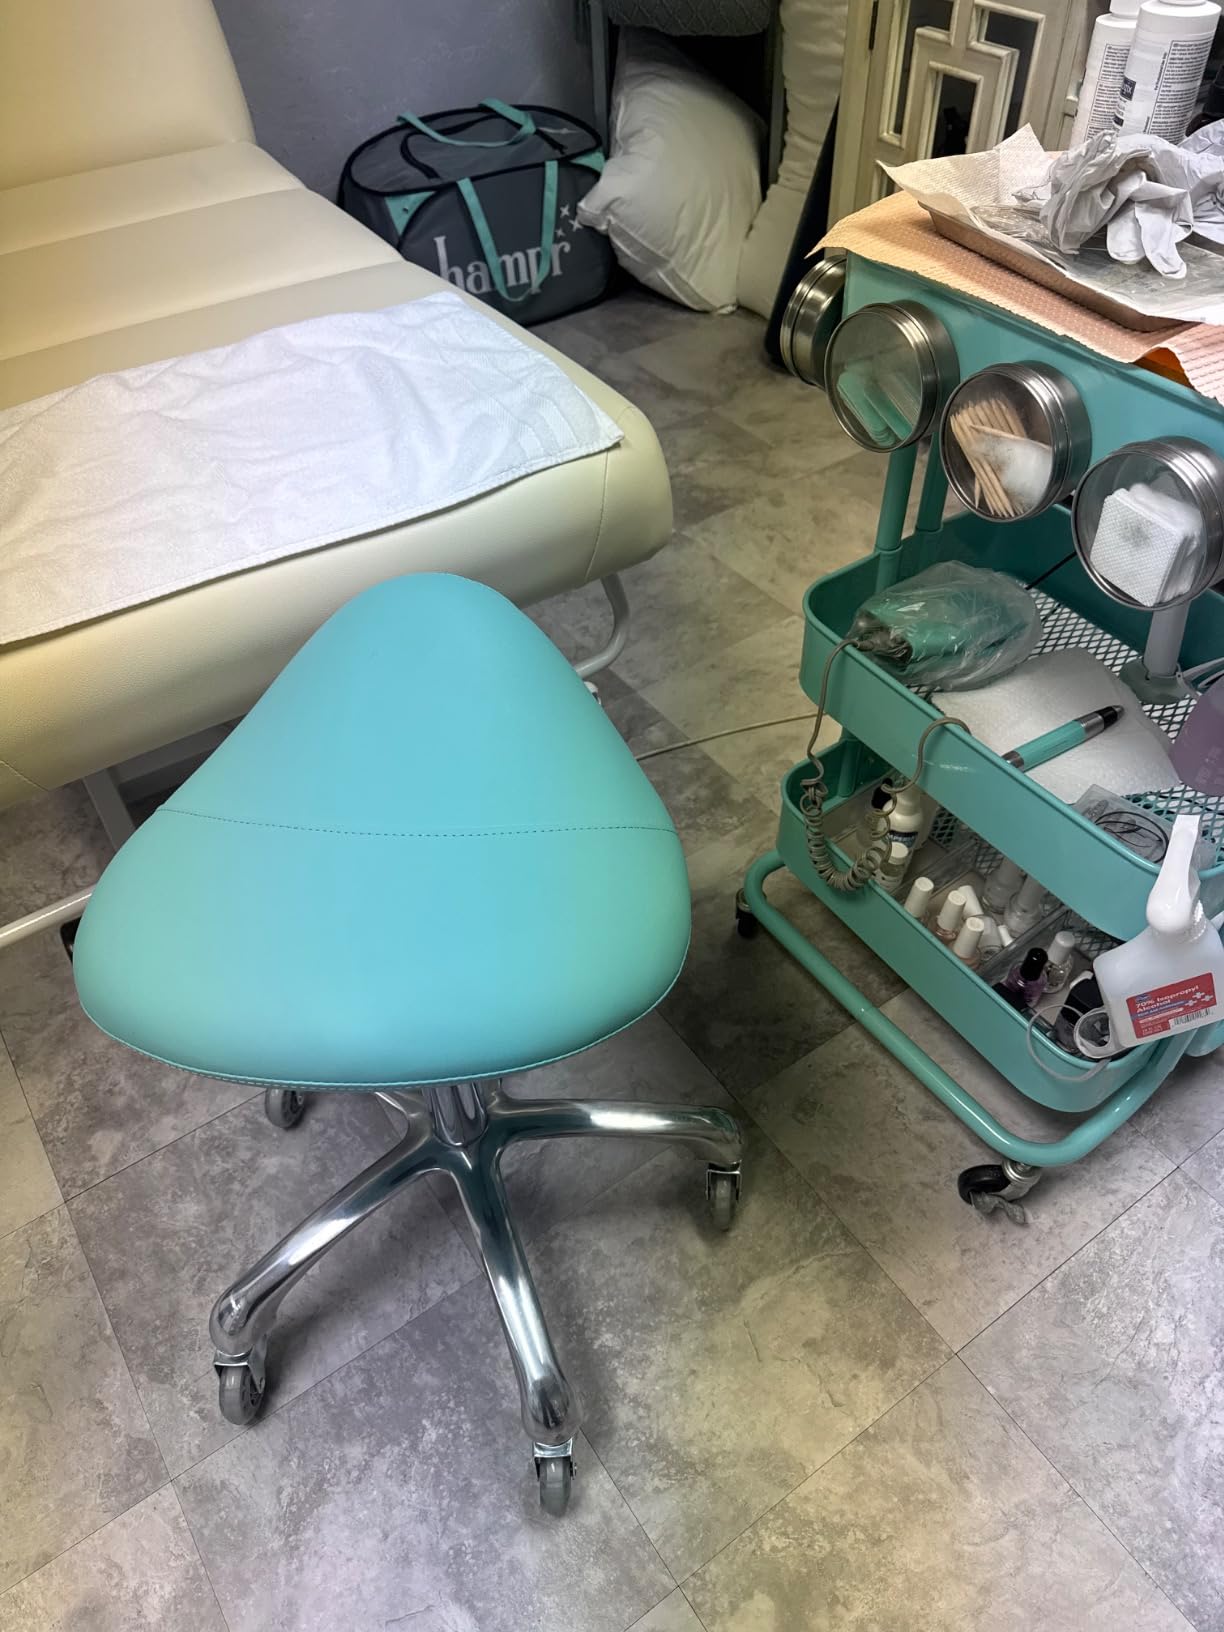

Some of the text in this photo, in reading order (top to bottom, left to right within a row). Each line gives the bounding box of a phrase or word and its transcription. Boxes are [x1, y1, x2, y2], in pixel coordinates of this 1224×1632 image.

[434, 236, 571, 295] hampr
[1135, 1000, 1155, 1008] 70%
[1157, 985, 1199, 1001] Isopropyl
[1136, 1000, 1171, 1013] Alcohol
